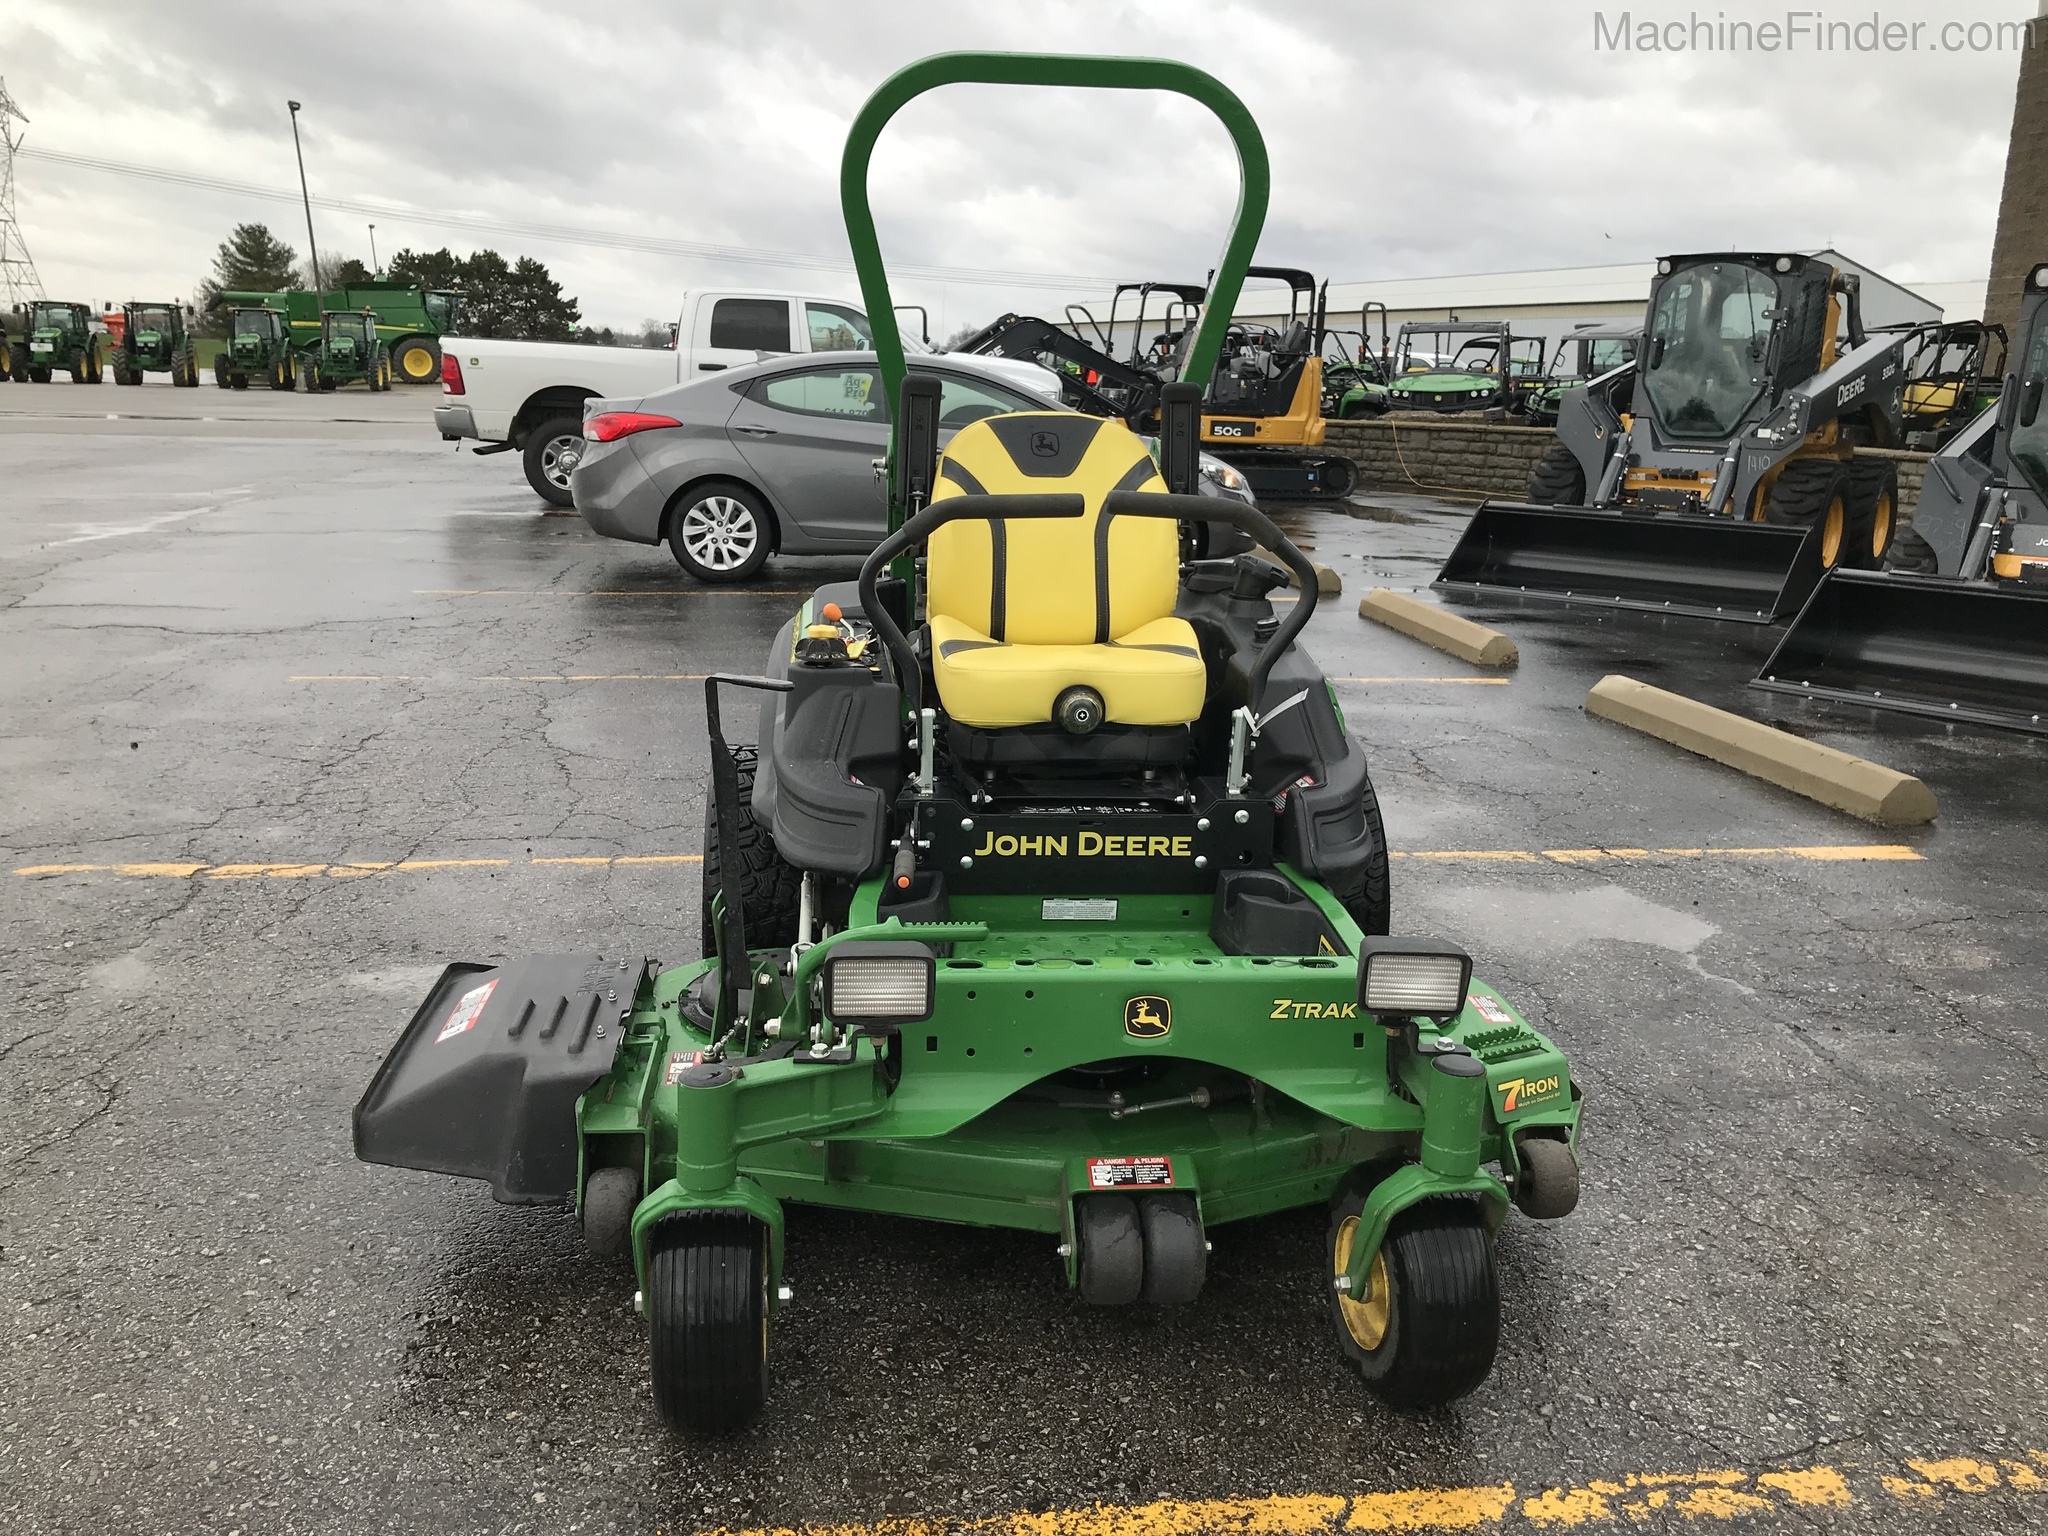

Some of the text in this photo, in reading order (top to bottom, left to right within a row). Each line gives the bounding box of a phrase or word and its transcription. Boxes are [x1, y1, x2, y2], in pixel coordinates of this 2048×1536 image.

[844, 387, 865, 398] Pro
[1837, 374, 1866, 407] DEERE
[1213, 425, 1242, 437] 50G
[974, 831, 1192, 856] JOHN DEERE
[1270, 999, 1358, 1019] ZTRAK
